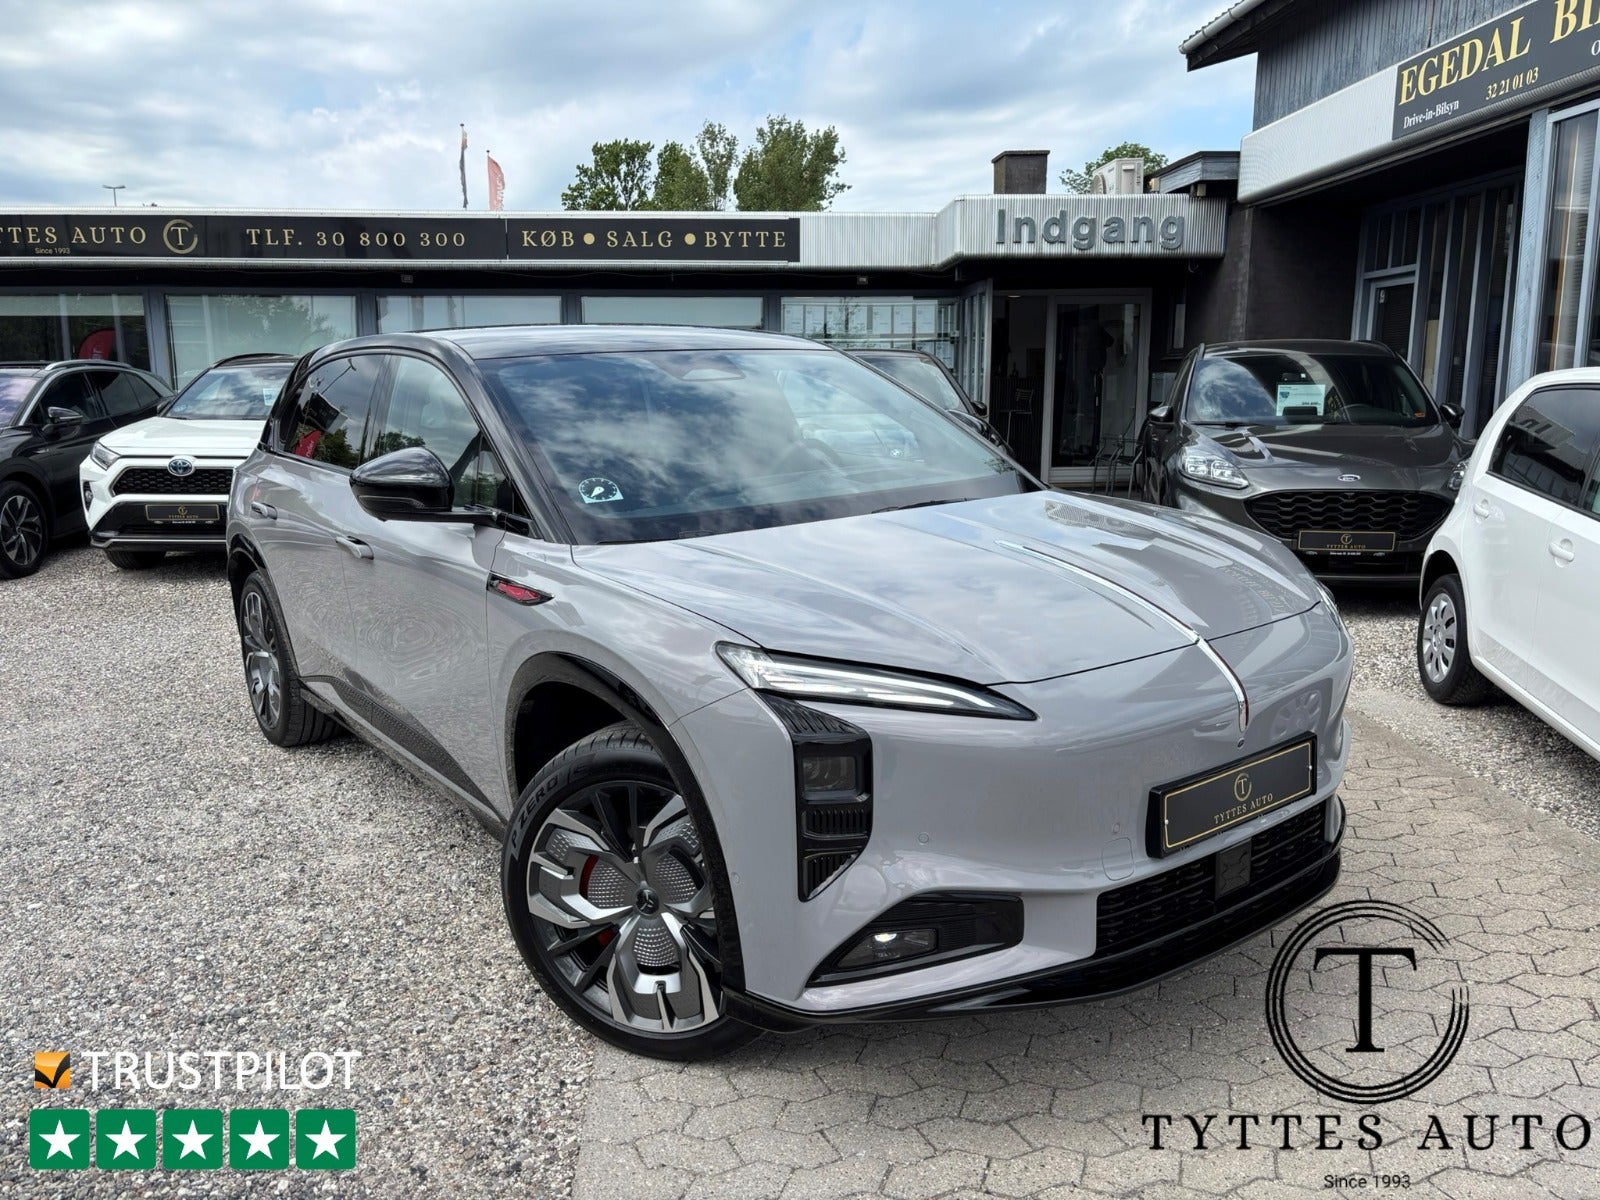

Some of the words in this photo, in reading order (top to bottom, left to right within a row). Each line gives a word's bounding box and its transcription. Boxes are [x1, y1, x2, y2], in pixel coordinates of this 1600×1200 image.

[1398, 16, 1532, 106] EGEDAL
[1549, 0, 1600, 44] BI
[1486, 85, 1497, 100] 32
[1499, 80, 1509, 96] 21
[1513, 75, 1523, 91] 01
[1526, 66, 1539, 86] 03
[1403, 99, 1460, 129] Drive-in-Bilsyn
[0, 226, 57, 244] TES
[71, 226, 148, 245] AUTO
[246, 228, 303, 246] TLF.
[316, 231, 346, 247] 30
[360, 231, 407, 248] 800
[420, 231, 466, 248] 300
[521, 230, 576, 248] KØB
[606, 230, 674, 248] SALG
[704, 230, 787, 249] BYTTE
[996, 208, 1185, 250] Indgang
[519, 775, 559, 830] ZERO
[1214, 804, 1246, 824] TYTTES
[1251, 793, 1273, 809] AUTO
